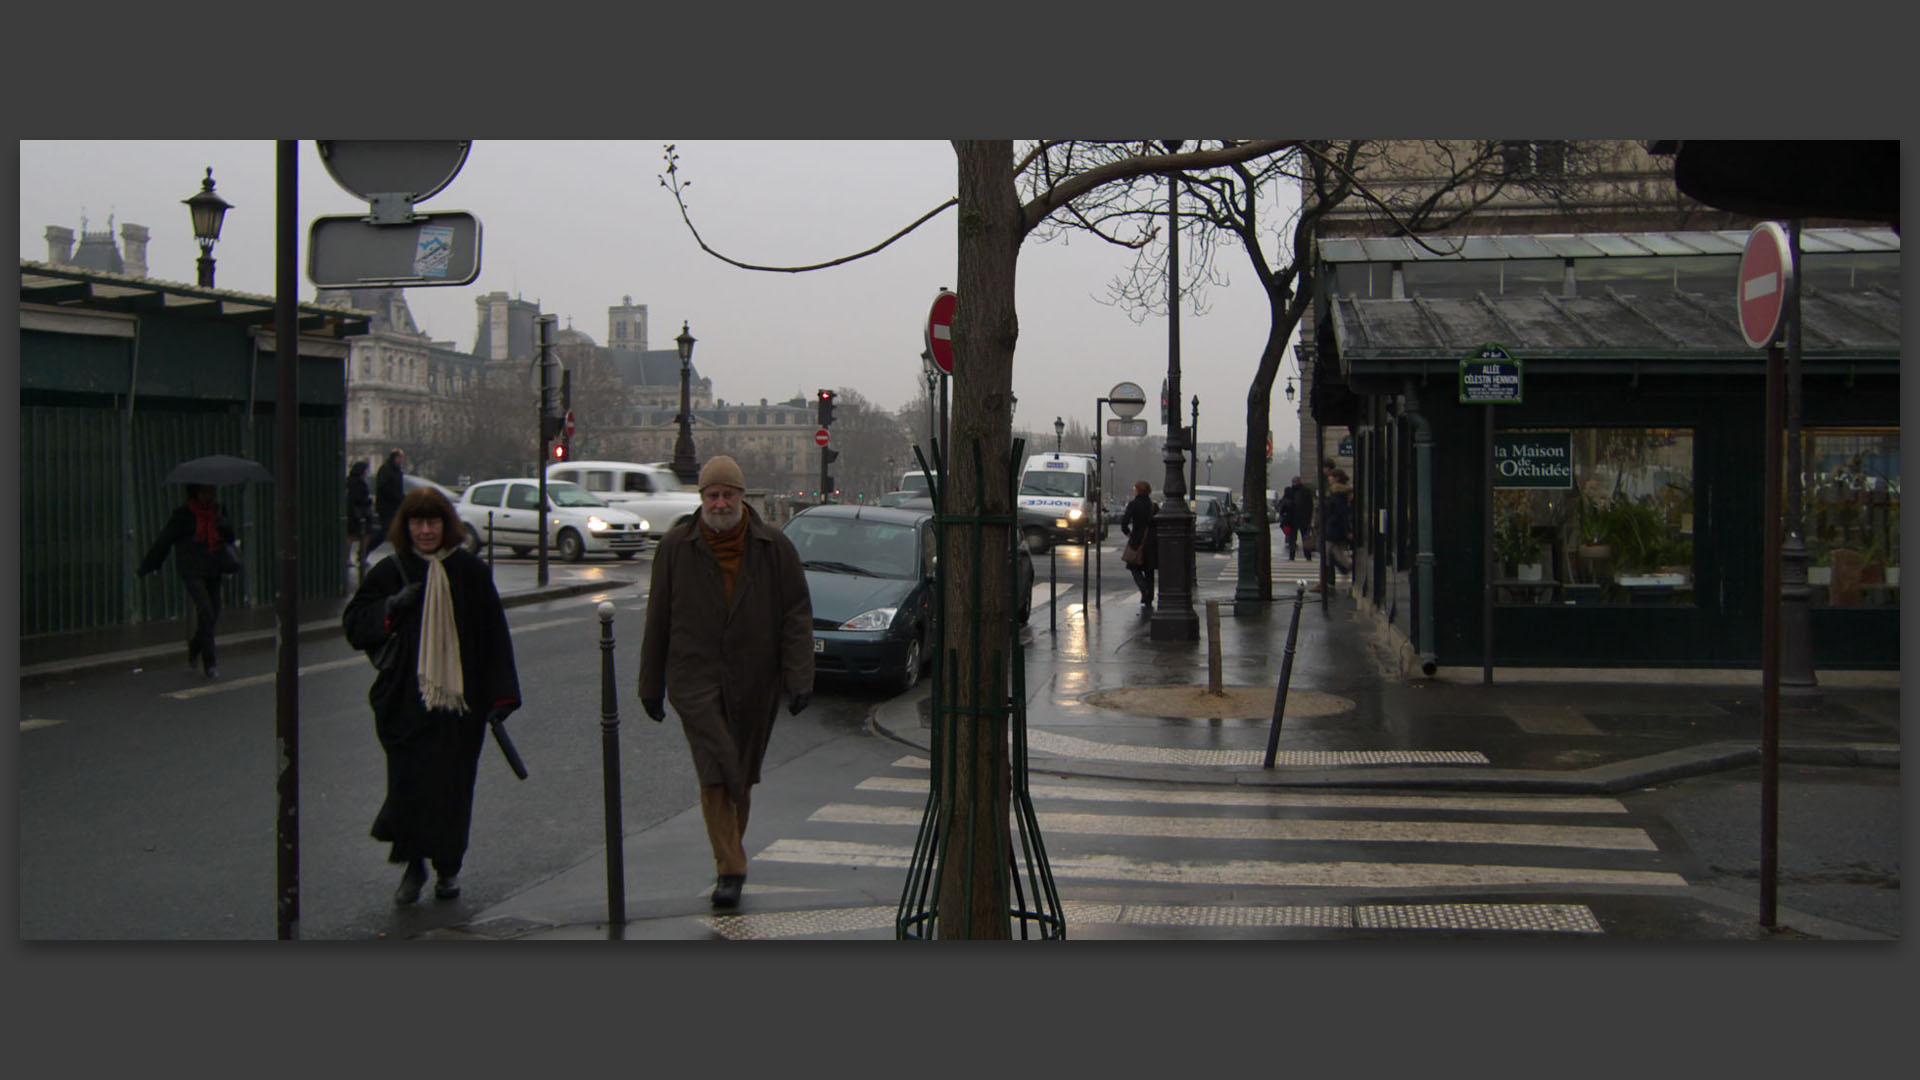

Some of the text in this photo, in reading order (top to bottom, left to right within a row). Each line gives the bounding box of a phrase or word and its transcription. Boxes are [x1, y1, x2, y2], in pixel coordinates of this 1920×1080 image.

[1483, 364, 1500, 374] ALLÉE
[1464, 373, 1491, 384] CÉLESTIN
[1494, 443, 1564, 457] la Maison
[1517, 457, 1531, 467] de
[1495, 459, 1570, 477] 'Orchidée
